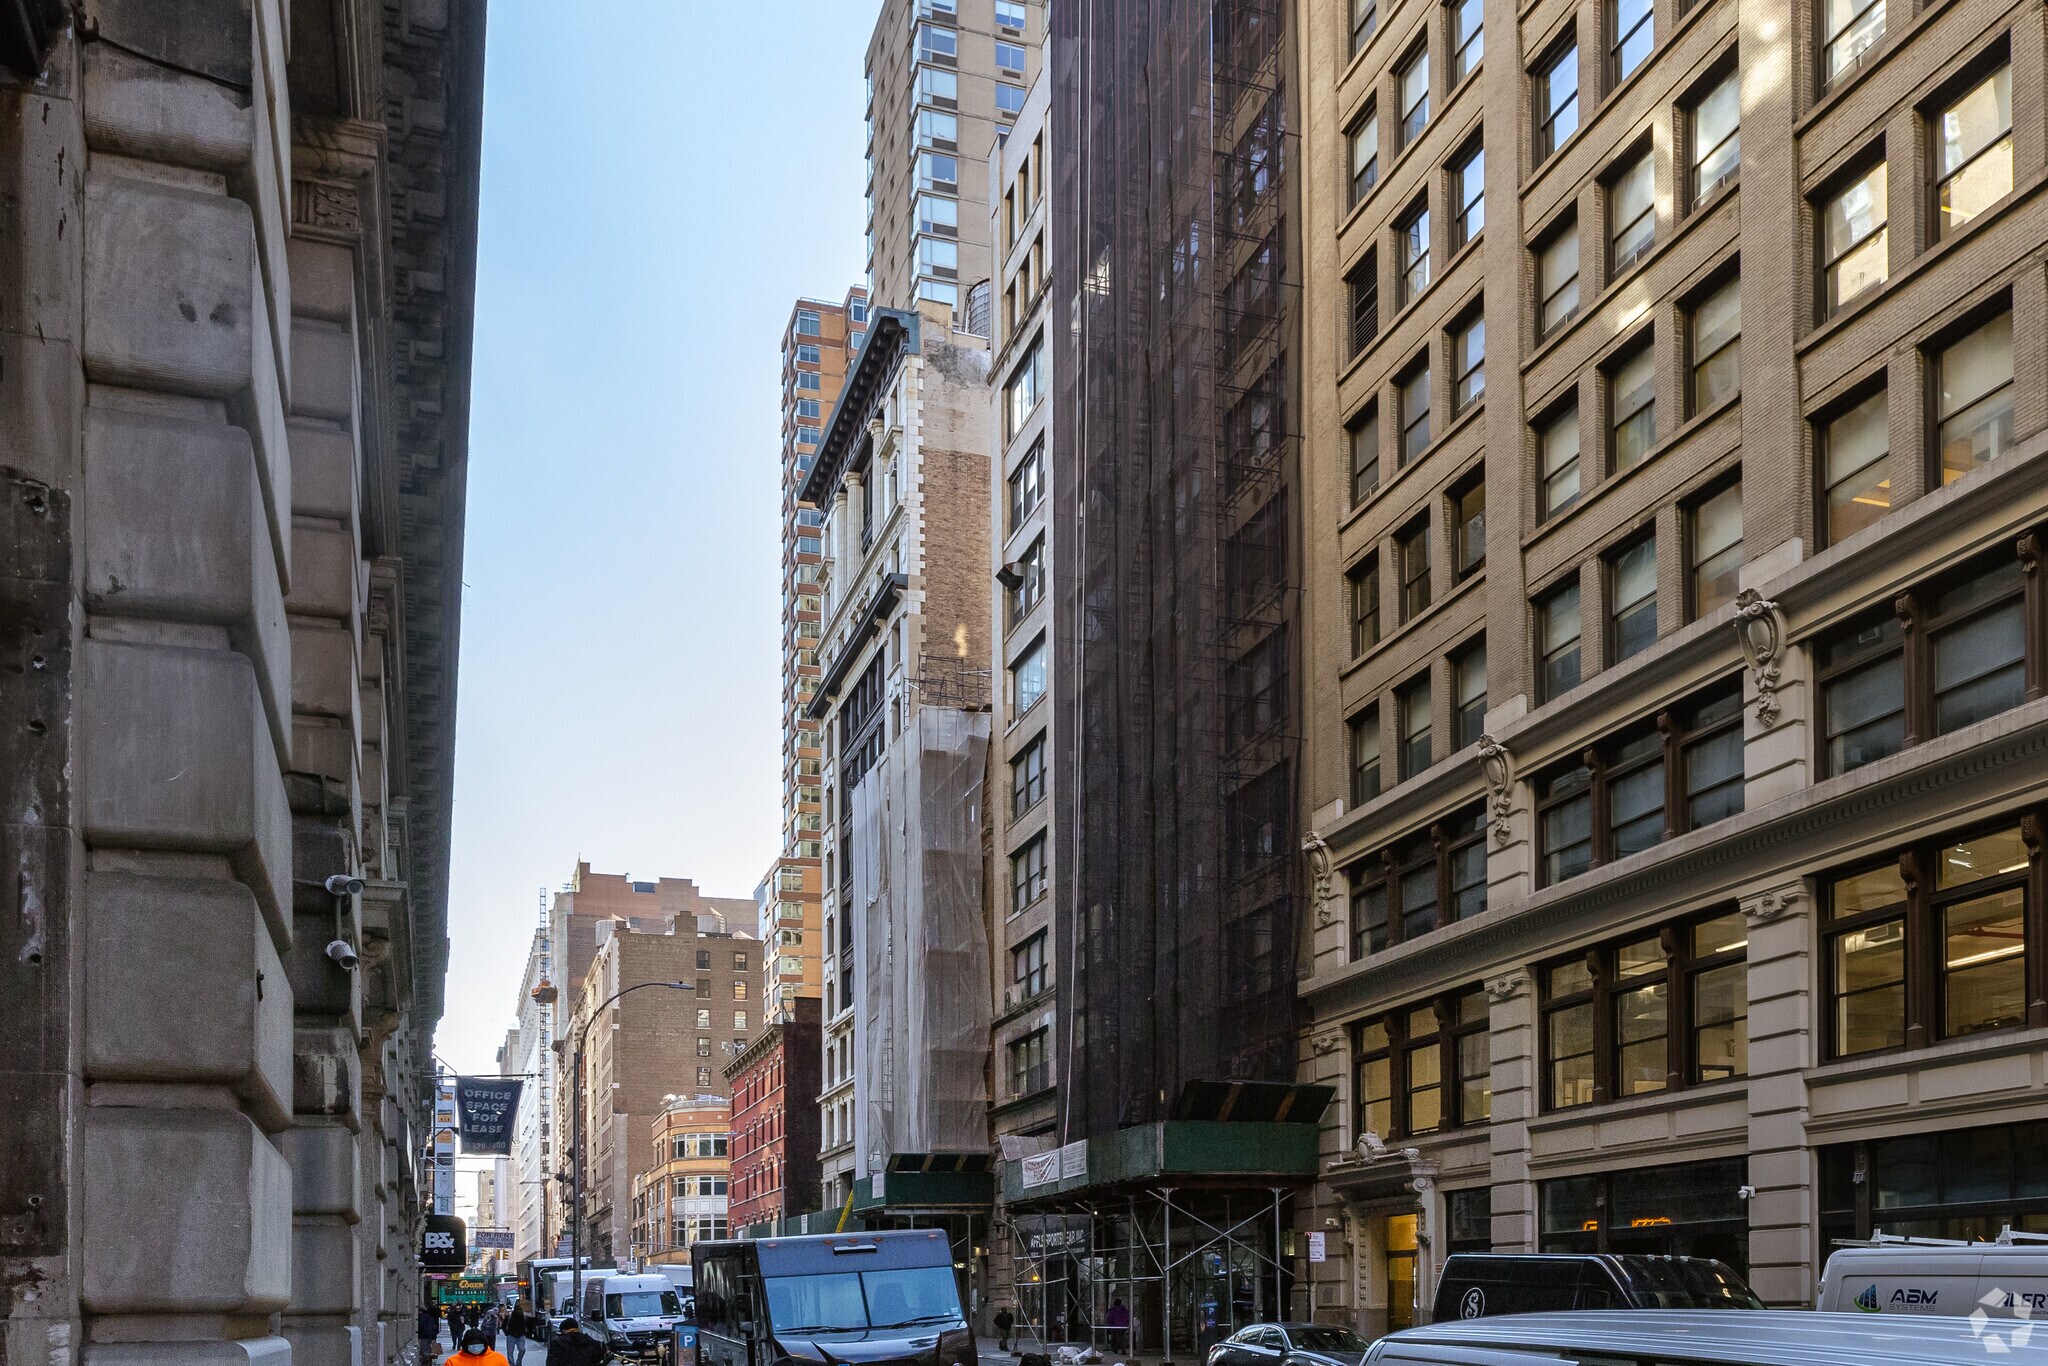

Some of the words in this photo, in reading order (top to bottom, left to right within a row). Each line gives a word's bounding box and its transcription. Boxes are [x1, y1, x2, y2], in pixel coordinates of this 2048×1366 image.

[464, 1089, 511, 1100] OFFICE
[466, 1101, 508, 1111] SPACE
[473, 1113, 499, 1122] FOR
[464, 1124, 503, 1133] LEASE
[1890, 1288, 1938, 1304] ABM
[1889, 1303, 1936, 1312] SYSTEMS
[684, 1335, 693, 1347] P
